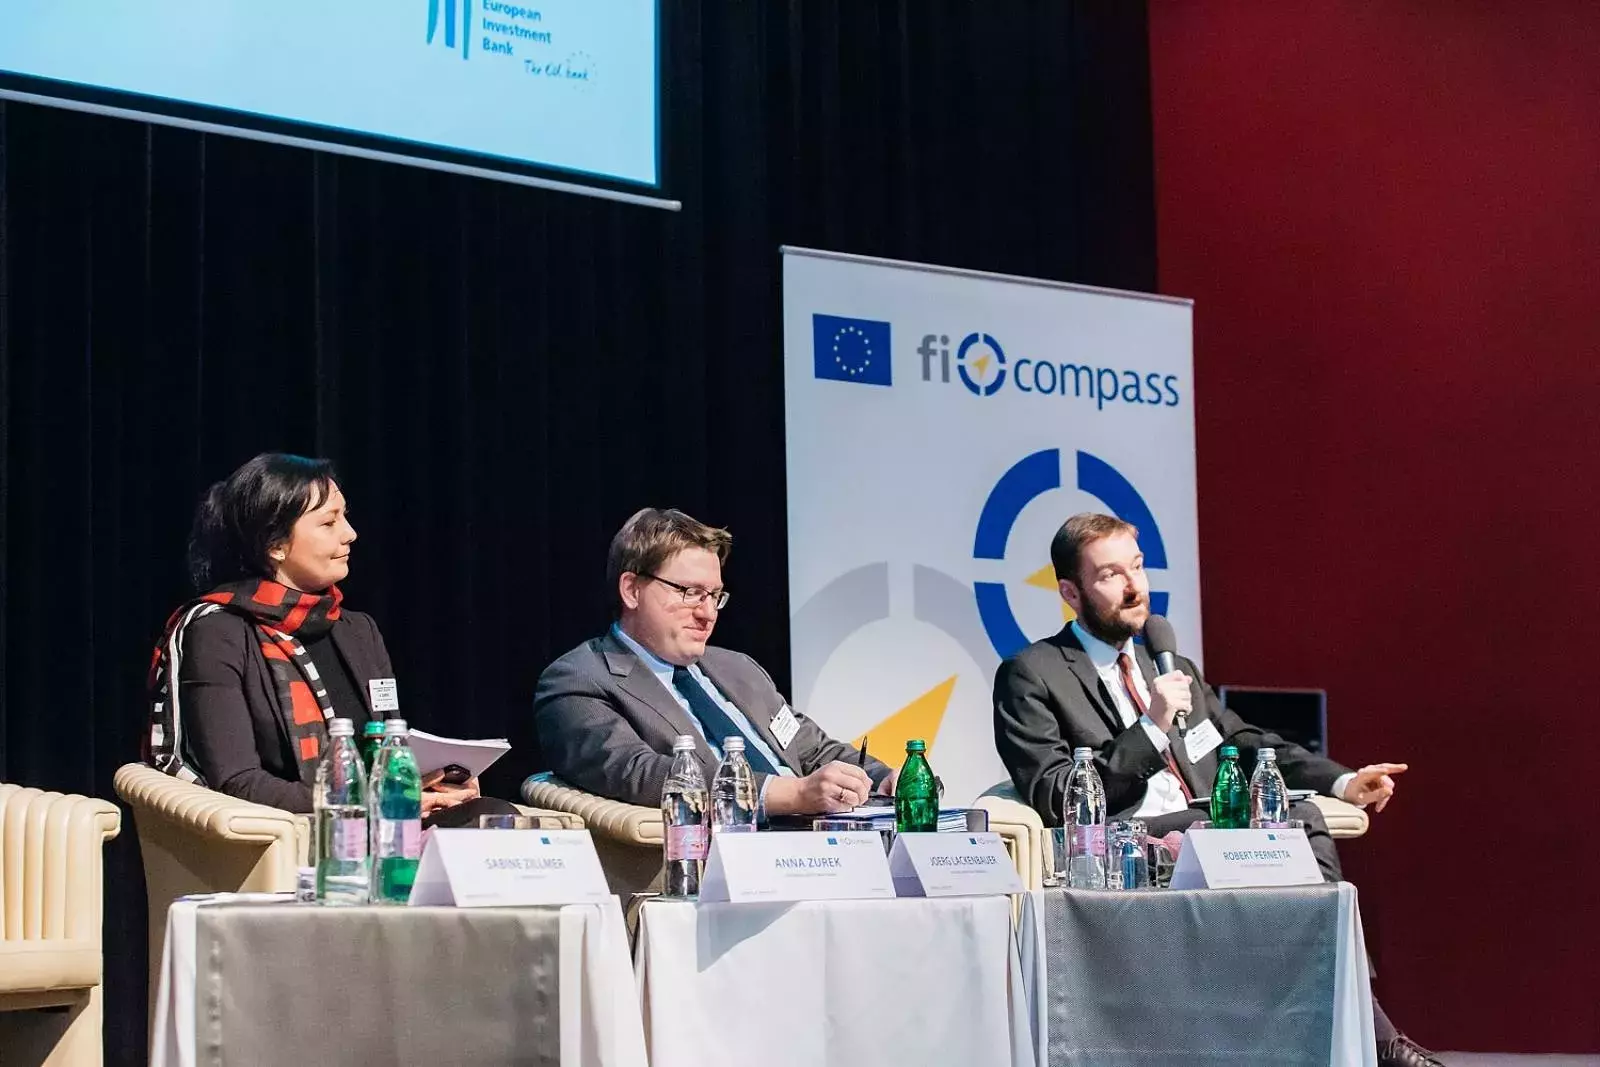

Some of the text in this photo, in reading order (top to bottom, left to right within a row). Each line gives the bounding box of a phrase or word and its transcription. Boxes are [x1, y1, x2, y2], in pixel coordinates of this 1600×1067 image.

[483, 0, 542, 21] European
[483, 17, 552, 43] Investment
[482, 37, 514, 56] Bank
[1014, 358, 1179, 411] compass
[485, 858, 566, 869] SABINE ZILLMER
[775, 857, 842, 868] ANNA ZUREK
[1223, 850, 1292, 861] ROBERT PERNETTA
